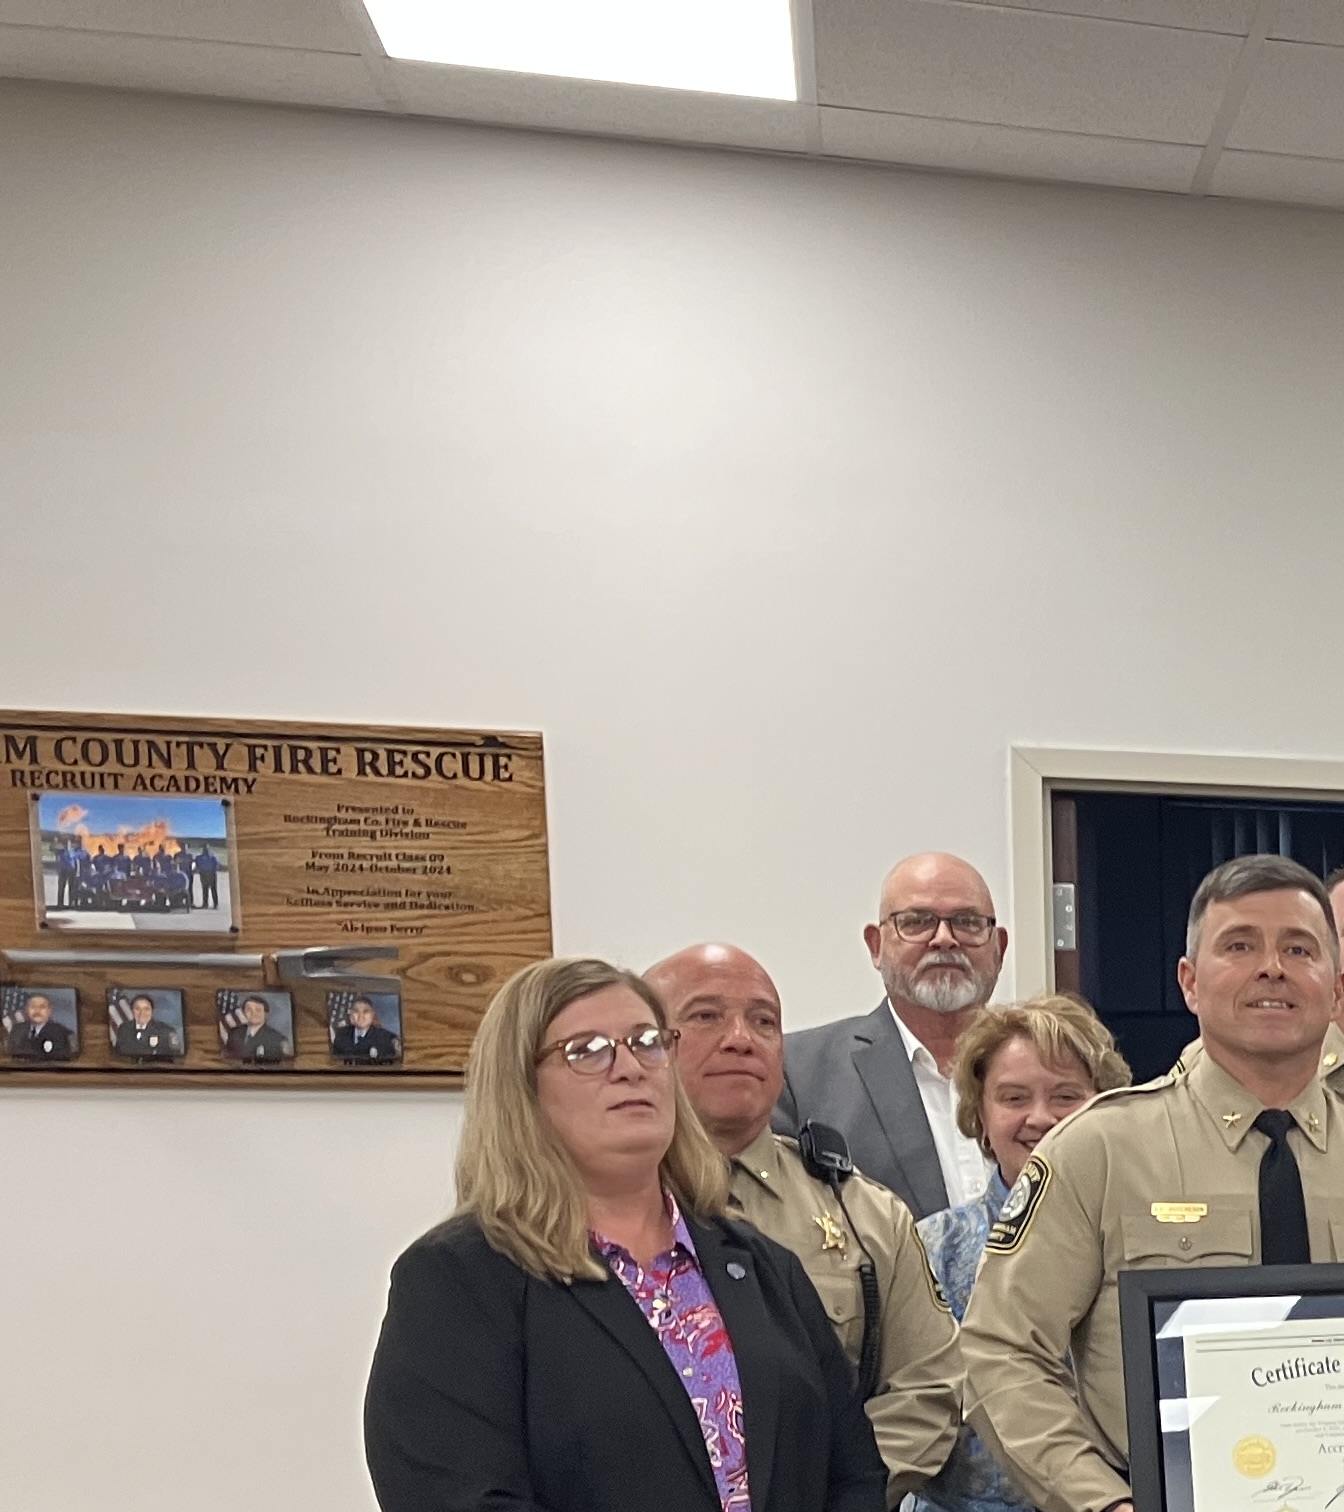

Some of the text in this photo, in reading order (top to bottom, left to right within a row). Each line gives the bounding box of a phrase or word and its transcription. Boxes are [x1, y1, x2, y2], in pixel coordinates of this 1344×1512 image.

[0, 733, 514, 782] M COUNTY FIRE RESCUE
[11, 769, 257, 795] RECRUIT ACADEMY
[336, 803, 415, 816] Presented to
[385, 817, 410, 828] Fire
[412, 817, 422, 828] &
[425, 818, 468, 830] Rescue
[324, 826, 431, 841] Training Division
[311, 850, 345, 860] From
[347, 851, 393, 862] Recruit
[395, 852, 427, 863] Class
[305, 861, 330, 873] May
[421, 864, 452, 876] 2024
[404, 889, 422, 898] for
[1251, 1354, 1341, 1387] Certificate
[1268, 1402, 1342, 1416] Rockingham
